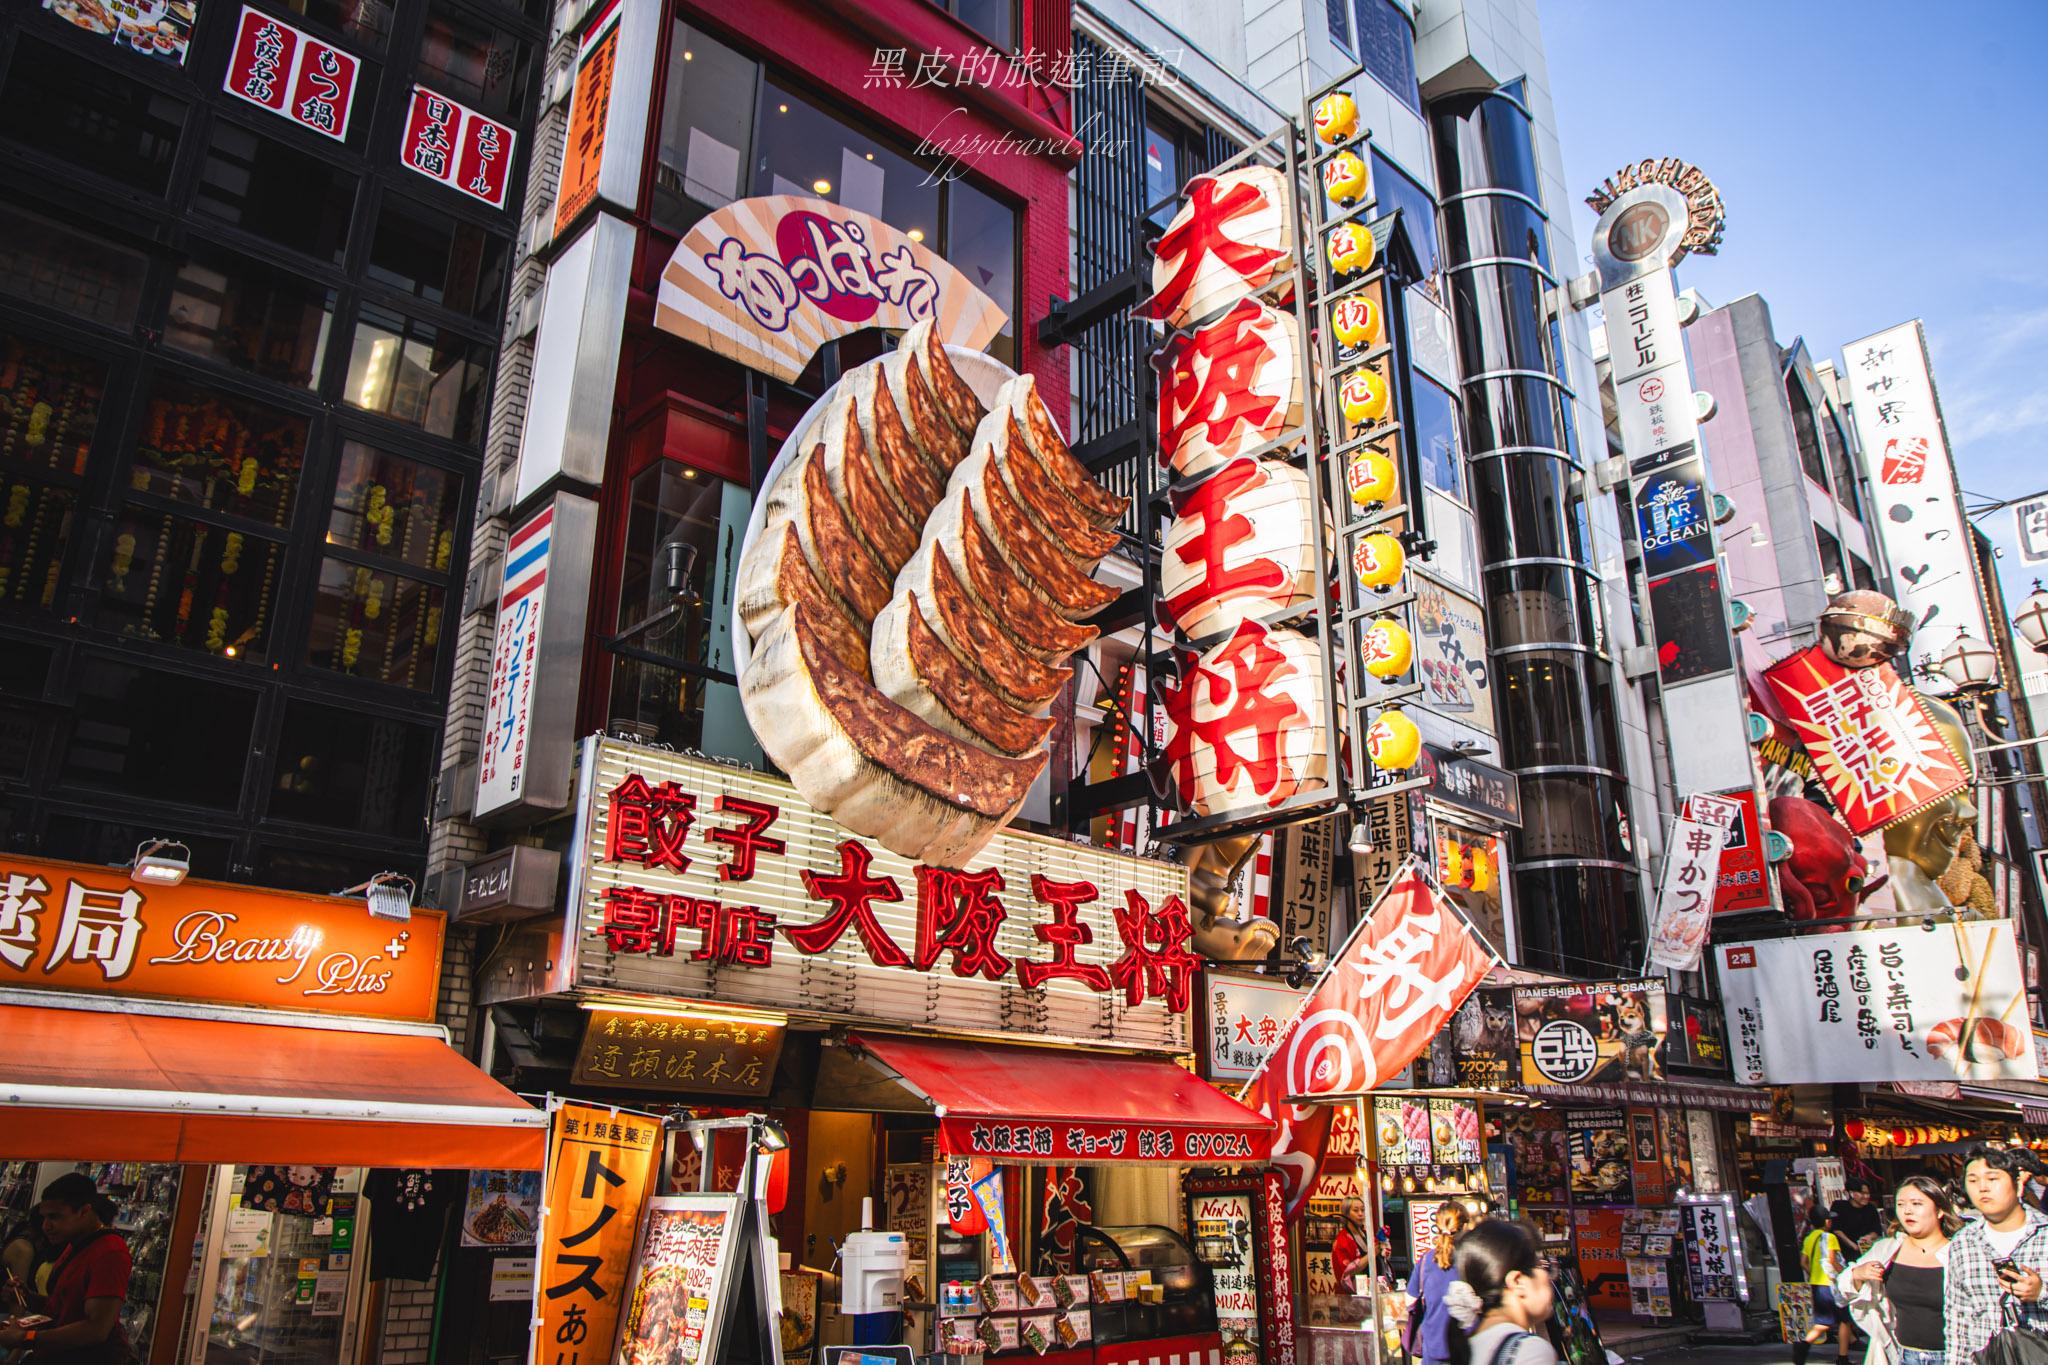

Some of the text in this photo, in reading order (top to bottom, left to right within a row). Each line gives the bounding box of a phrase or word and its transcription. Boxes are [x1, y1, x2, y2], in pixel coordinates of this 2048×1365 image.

[246, 22, 282, 103] 大阪名物
[299, 49, 341, 132] もつ鍋
[413, 96, 454, 176] 日本酒
[468, 123, 502, 196] 生ビール
[1656, 451, 1670, 463] 4F
[1129, 176, 1297, 818] 大阪王将
[1653, 501, 1692, 526] BAR
[1643, 519, 1711, 550] OCEAN
[489, 617, 513, 780] タイカルチャースクール
[501, 597, 529, 753] クンテープ
[512, 600, 539, 770] タイ料理とタイスキの店
[1789, 751, 1811, 778] YAK
[1806, 691, 1890, 804] ミュージアム
[510, 774, 520, 792] B1
[604, 773, 787, 883] 餃子
[1677, 828, 1713, 913] 串かつ
[151, 910, 326, 984] Beauty
[598, 885, 778, 969] 専門店
[774, 838, 1201, 1014] 大阪王将
[304, 951, 393, 996] Plus
[1517, 985, 1583, 999] MAMESHIBA
[1586, 984, 1617, 996] CAFE
[1813, 949, 1842, 1023] 居酒屋
[1213, 991, 1230, 1060] 景品付
[588, 1044, 765, 1088] 道頓堀本店
[1468, 1073, 1499, 1081] OSAKA
[564, 1118, 654, 1145] 第1類医薬品
[972, 1123, 1252, 1156] 大阪王将 ギョーザ 餃子 GYOZA
[1405, 1139, 1431, 1152] WAGYU
[1457, 1139, 1479, 1151] WAGYU
[1200, 1198, 1243, 1217] NINJA
[1526, 1186, 1544, 1201] 2F
[1699, 1208, 1726, 1275] お好み焼
[686, 1267, 713, 1290] 982円
